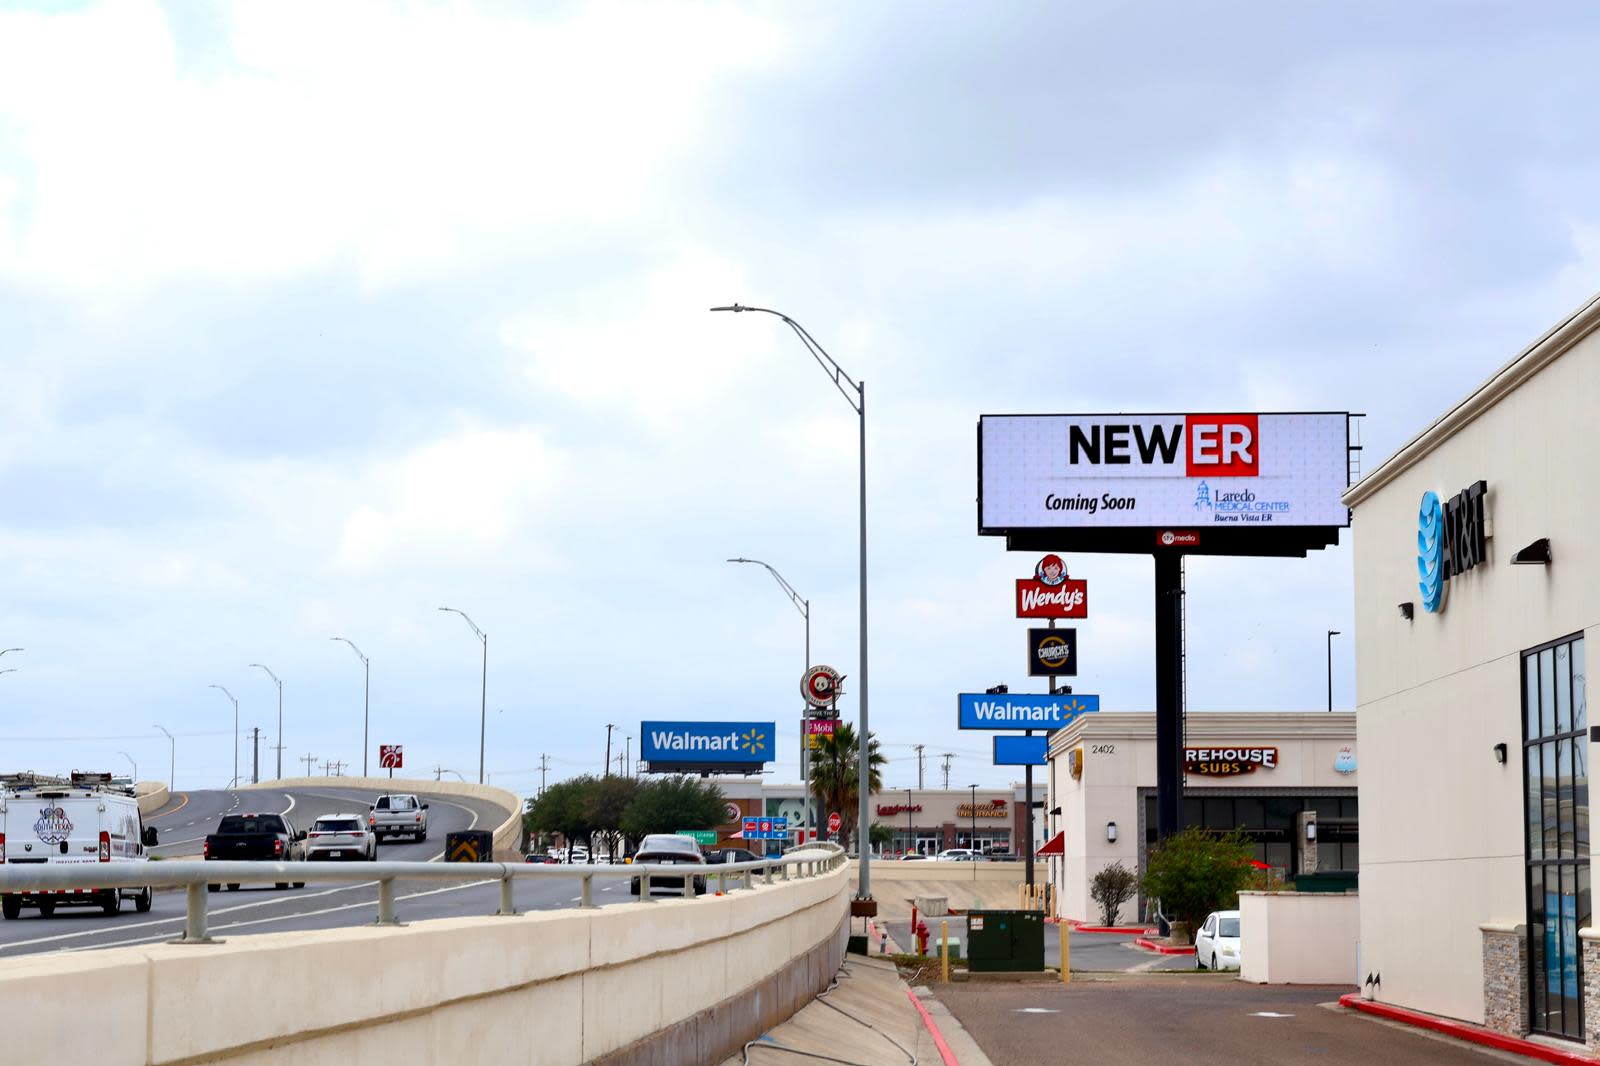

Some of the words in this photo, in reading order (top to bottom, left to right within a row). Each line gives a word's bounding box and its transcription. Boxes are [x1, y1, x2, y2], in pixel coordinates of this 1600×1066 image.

[1069, 424, 1183, 465] NEW
[1192, 423, 1253, 465] ER
[1045, 493, 1097, 514] Coming
[1100, 493, 1136, 510] Soon
[1215, 489, 1256, 502] Laredo
[1214, 502, 1253, 511] MEDICAL
[1254, 501, 1289, 511] CENTER
[1214, 514, 1239, 522] Buena
[1241, 513, 1260, 522] Vista
[1261, 513, 1273, 522] ER
[1441, 480, 1487, 580] AT&T
[1021, 585, 1084, 612] Wendy's
[973, 702, 1060, 721] Walmart
[651, 730, 739, 751] Walmart
[1092, 744, 1115, 754] 2402
[1185, 749, 1276, 769] REHOUSE
[1200, 762, 1241, 774] SUBS
[33, 823, 53, 832] SOUTH
[54, 823, 74, 832] TEXAS
